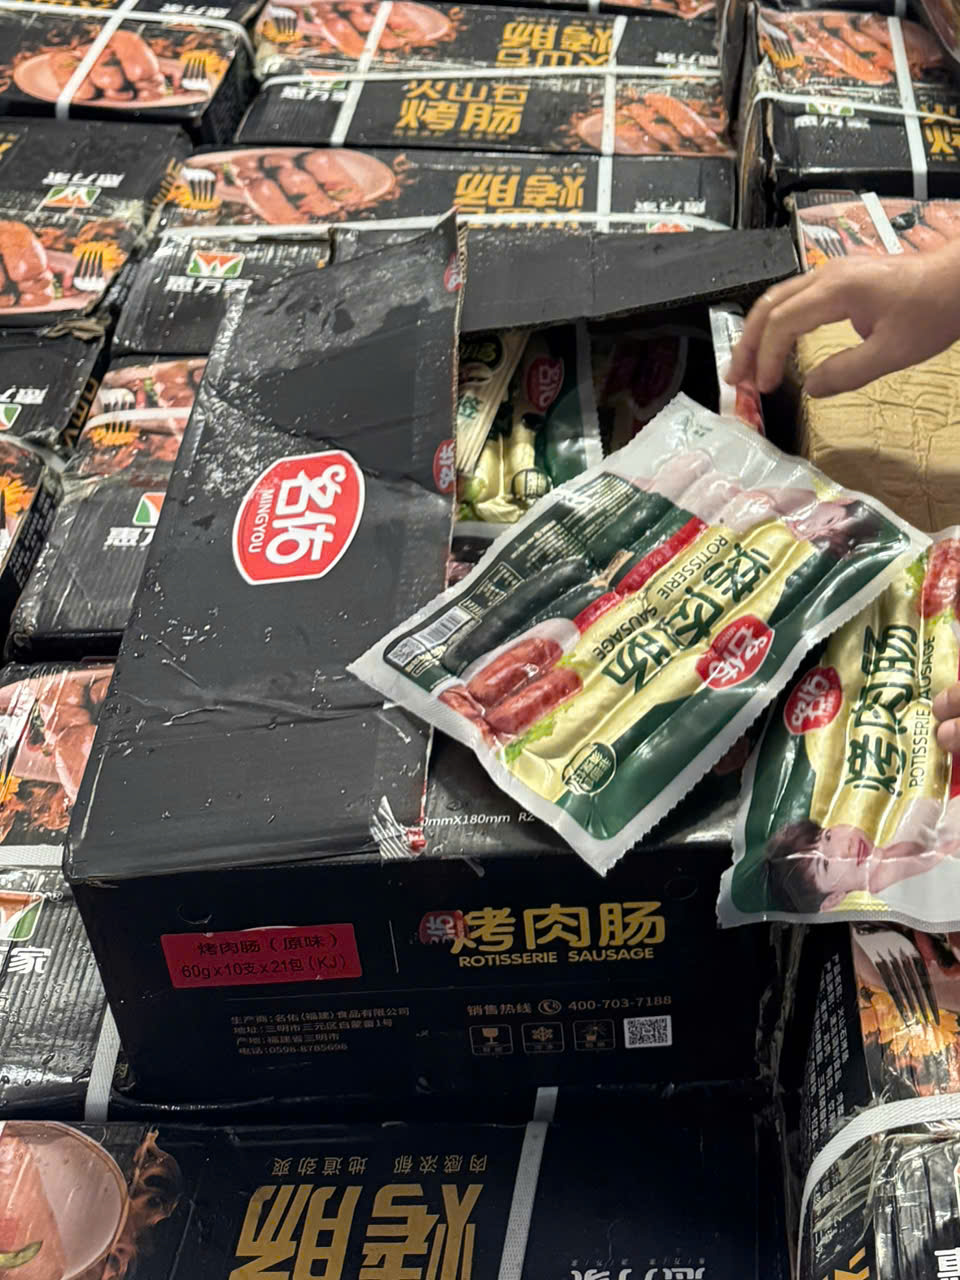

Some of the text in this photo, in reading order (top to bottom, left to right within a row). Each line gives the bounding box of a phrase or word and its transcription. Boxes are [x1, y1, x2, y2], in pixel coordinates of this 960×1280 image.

[395, 99, 526, 135] 烤肠
[454, 172, 586, 208] 烤肠
[247, 487, 276, 554] MINGYOU
[265, 463, 347, 565] 名佑
[656, 534, 729, 601] ROTISSERIE
[592, 605, 658, 660] SAUSAGE
[918, 635, 936, 700] AUSAGE
[450, 901, 666, 955] 烤肉肠
[458, 947, 655, 968] ROTISSERIE SAUSAGE
[567, 995, 673, 1012] 400-703-7188
[271, 1154, 489, 1178] 肉感浓郁 地道劲爽
[229, 1183, 485, 1280] 烤肠
